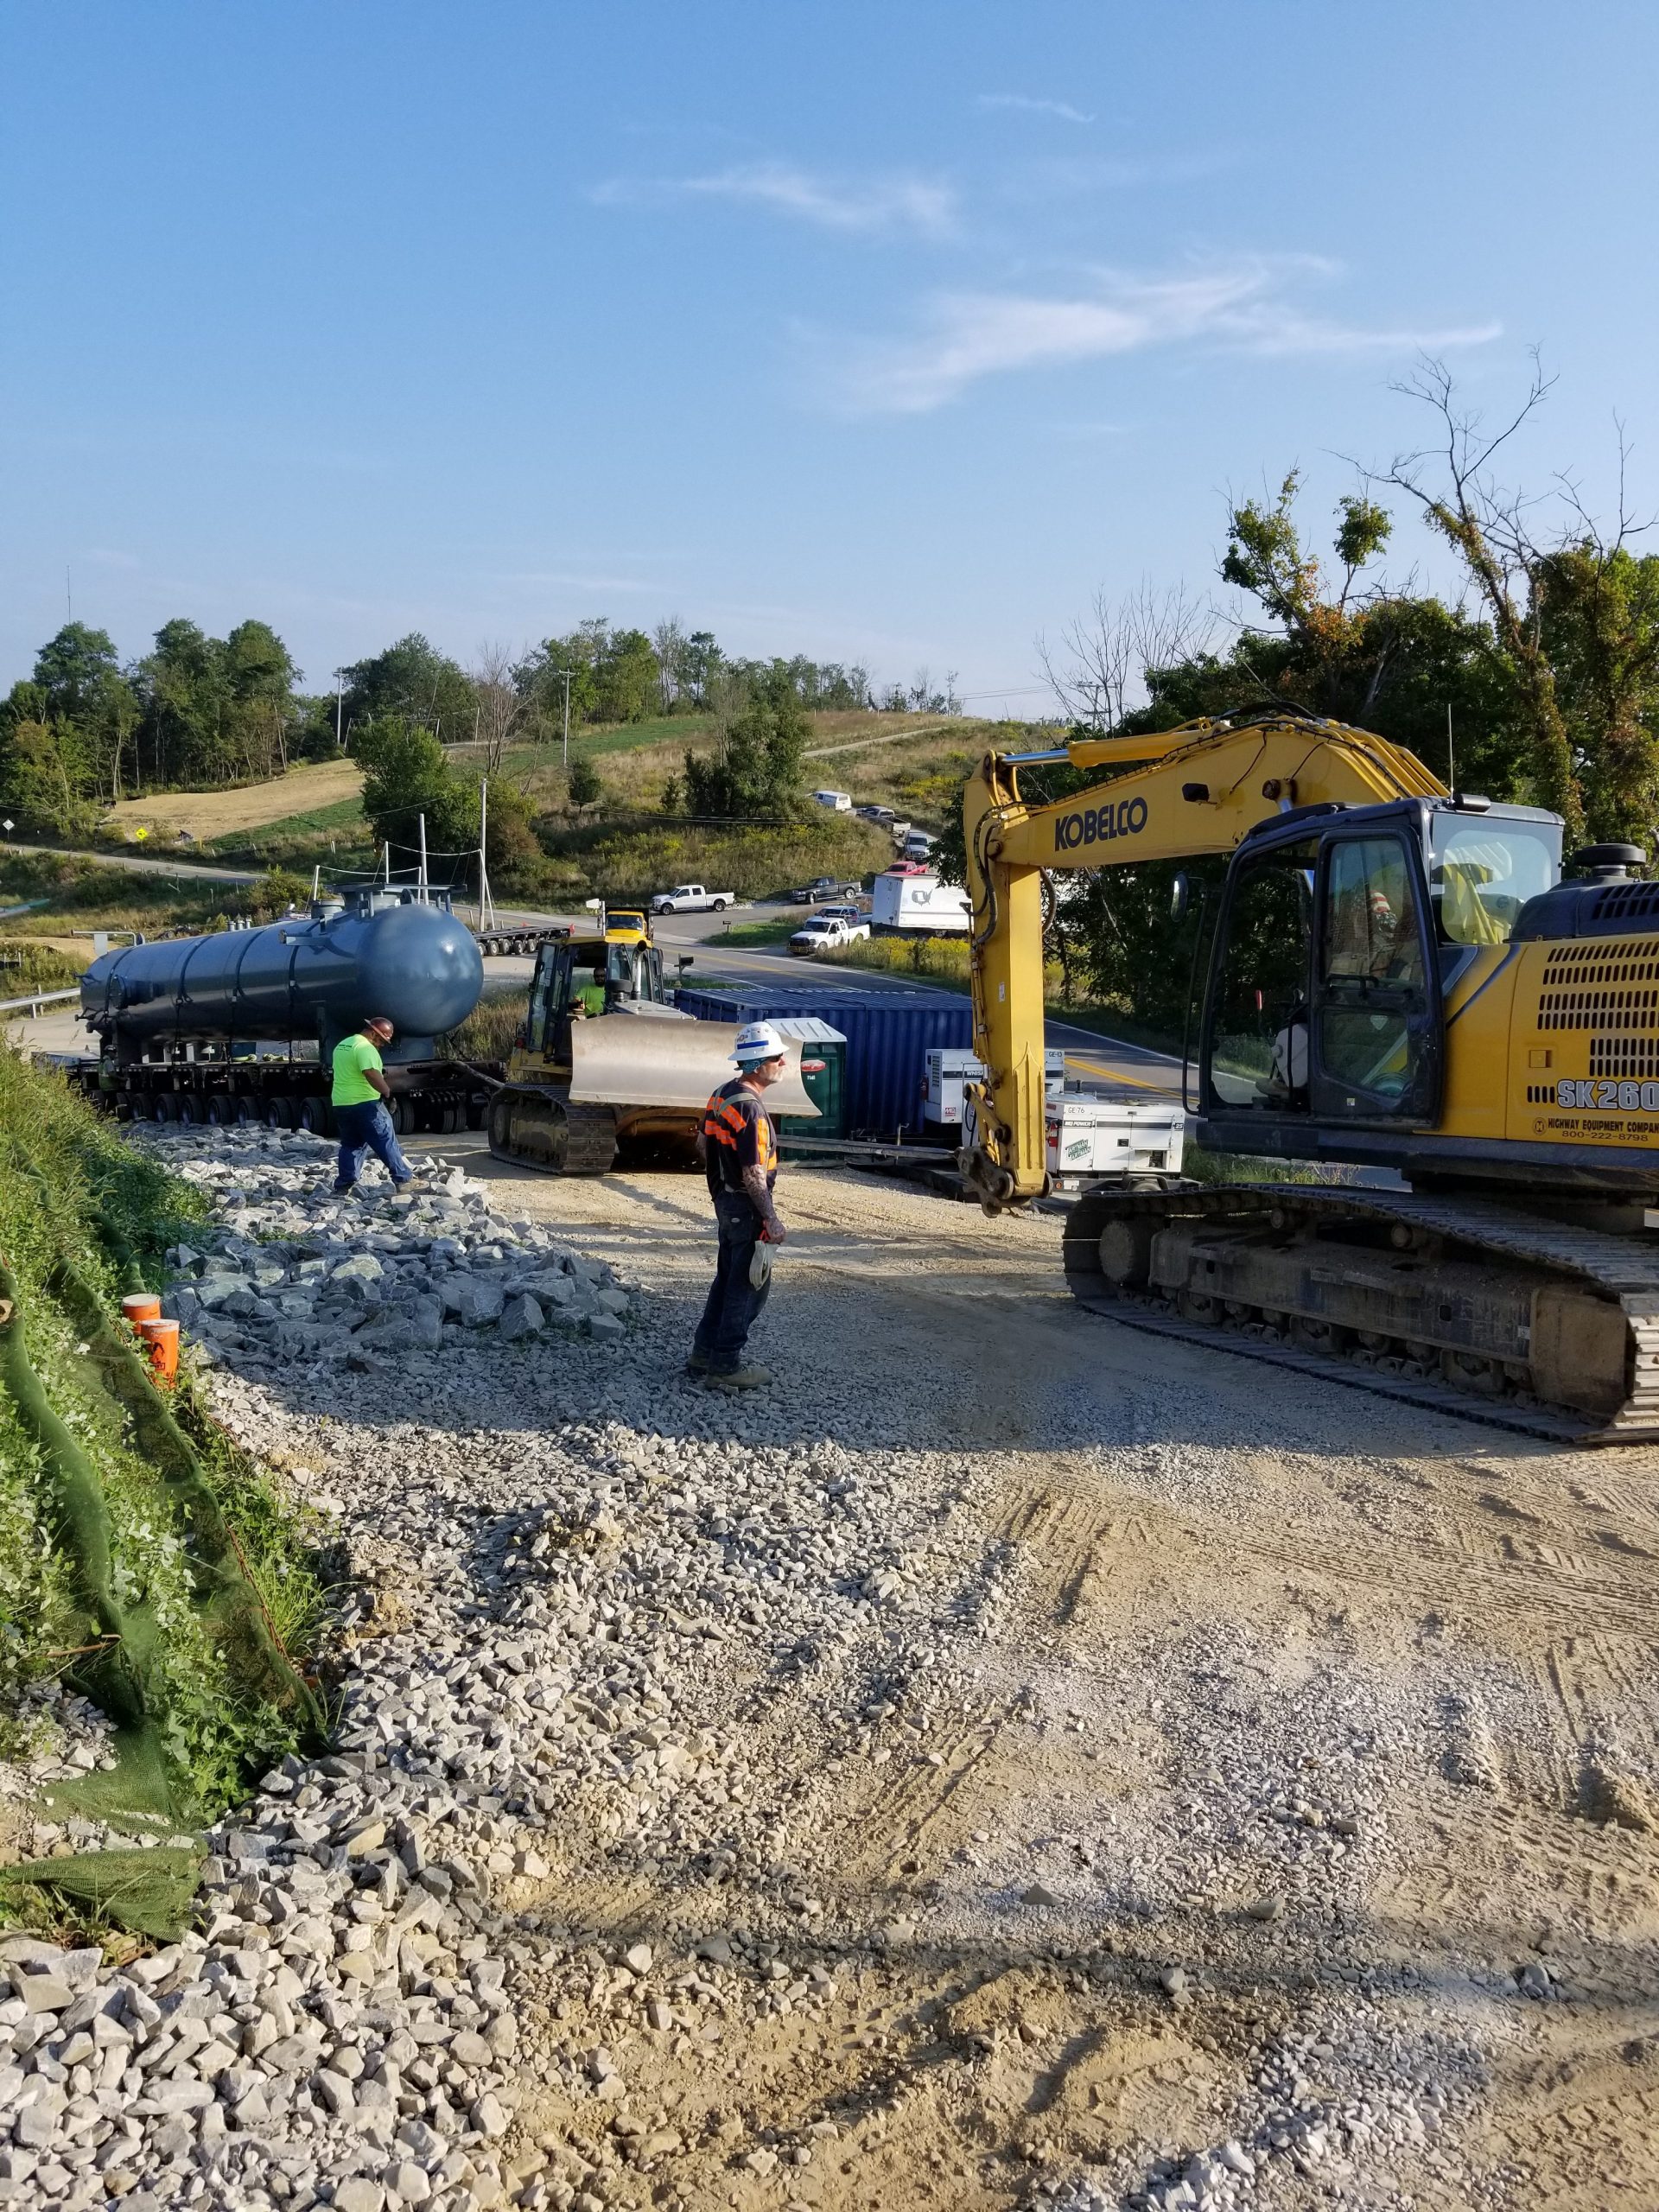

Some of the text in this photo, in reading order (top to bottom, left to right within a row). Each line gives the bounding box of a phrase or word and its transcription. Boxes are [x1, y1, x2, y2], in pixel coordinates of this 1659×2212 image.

[1055, 797, 1147, 851] KOBELCO
[1557, 1078, 1659, 1112] SK260
[1548, 1118, 1580, 1130] HIGHWAY
[1582, 1119, 1624, 1132] EQUIPMENT
[1562, 1130, 1649, 1141] 800-222-8798
